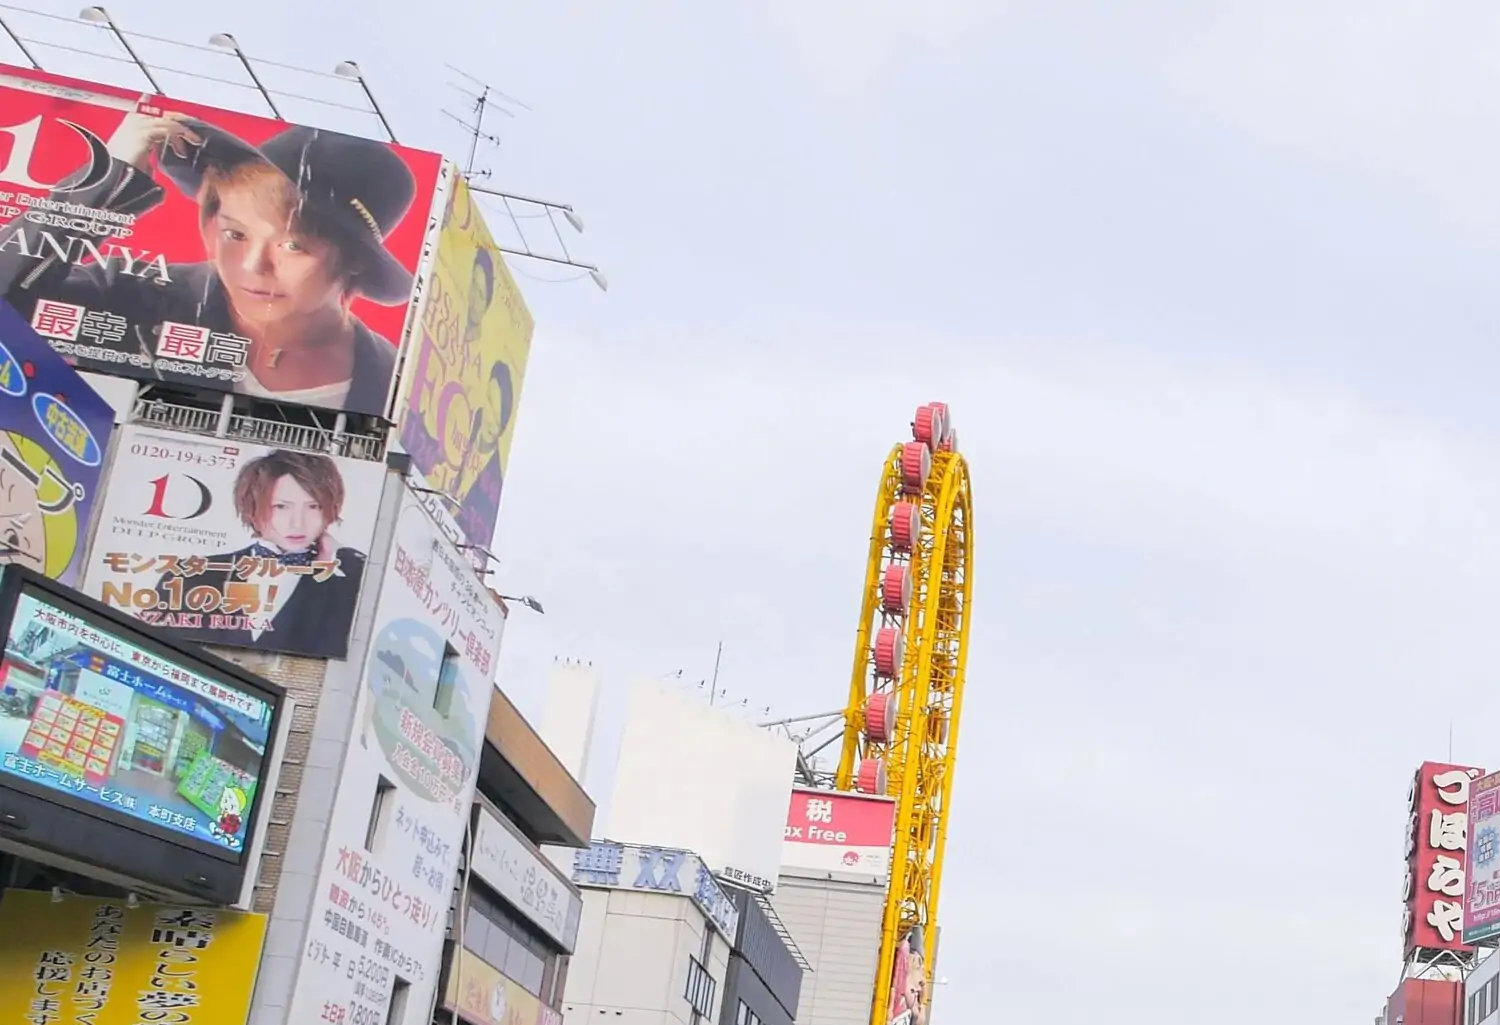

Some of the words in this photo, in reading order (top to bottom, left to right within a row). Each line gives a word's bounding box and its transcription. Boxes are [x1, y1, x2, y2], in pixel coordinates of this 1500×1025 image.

[16, 193, 136, 224] Entertainment
[25, 212, 133, 238] GROUP
[0, 227, 173, 283] ANNYA
[155, 321, 251, 368] 最高
[102, 552, 346, 583] モンスターグループ
[101, 581, 279, 614] No.1の男!
[210, 612, 274, 631] RUKA
[806, 797, 832, 824] 税
[784, 825, 803, 840] ax
[808, 824, 848, 843] Free
